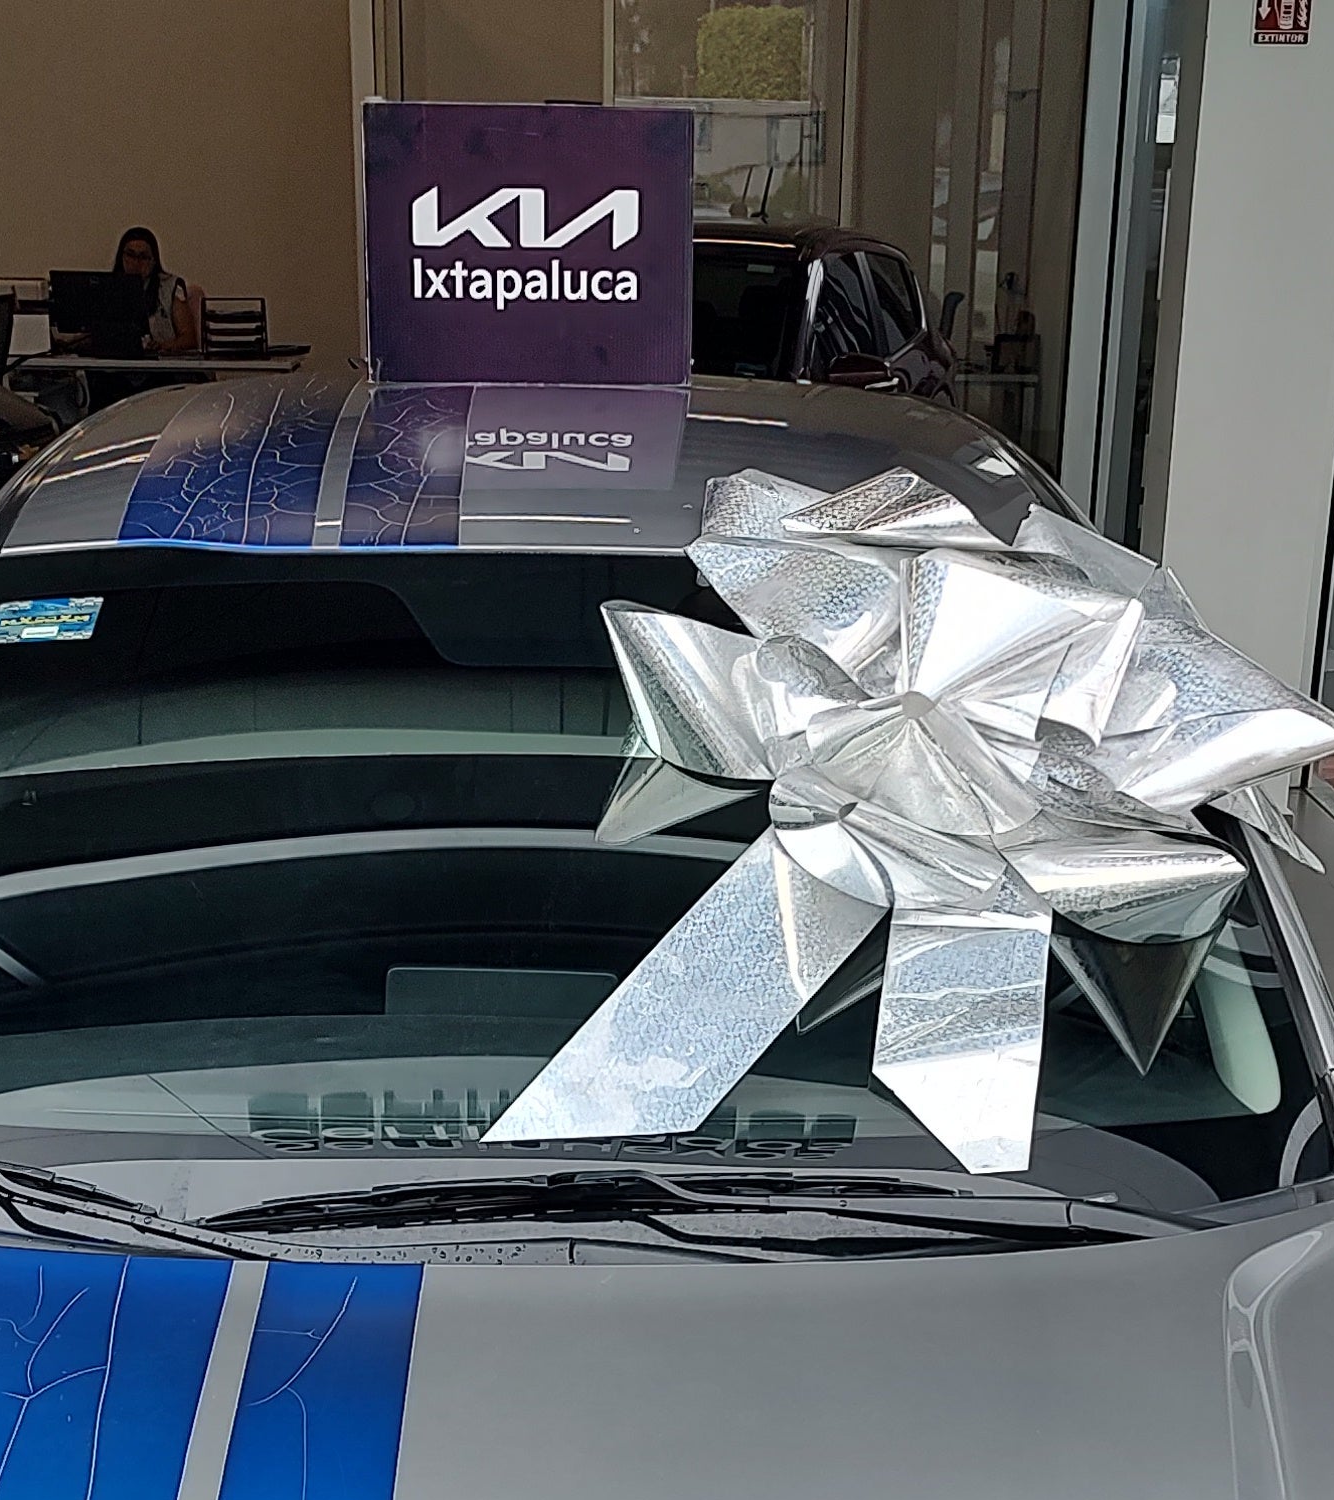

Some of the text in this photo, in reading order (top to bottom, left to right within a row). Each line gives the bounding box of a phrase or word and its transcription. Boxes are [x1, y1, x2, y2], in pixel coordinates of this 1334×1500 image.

[1257, 33, 1305, 43] EXTINTOR
[411, 187, 639, 249] KIA
[413, 257, 639, 308] Ixtapaluca
